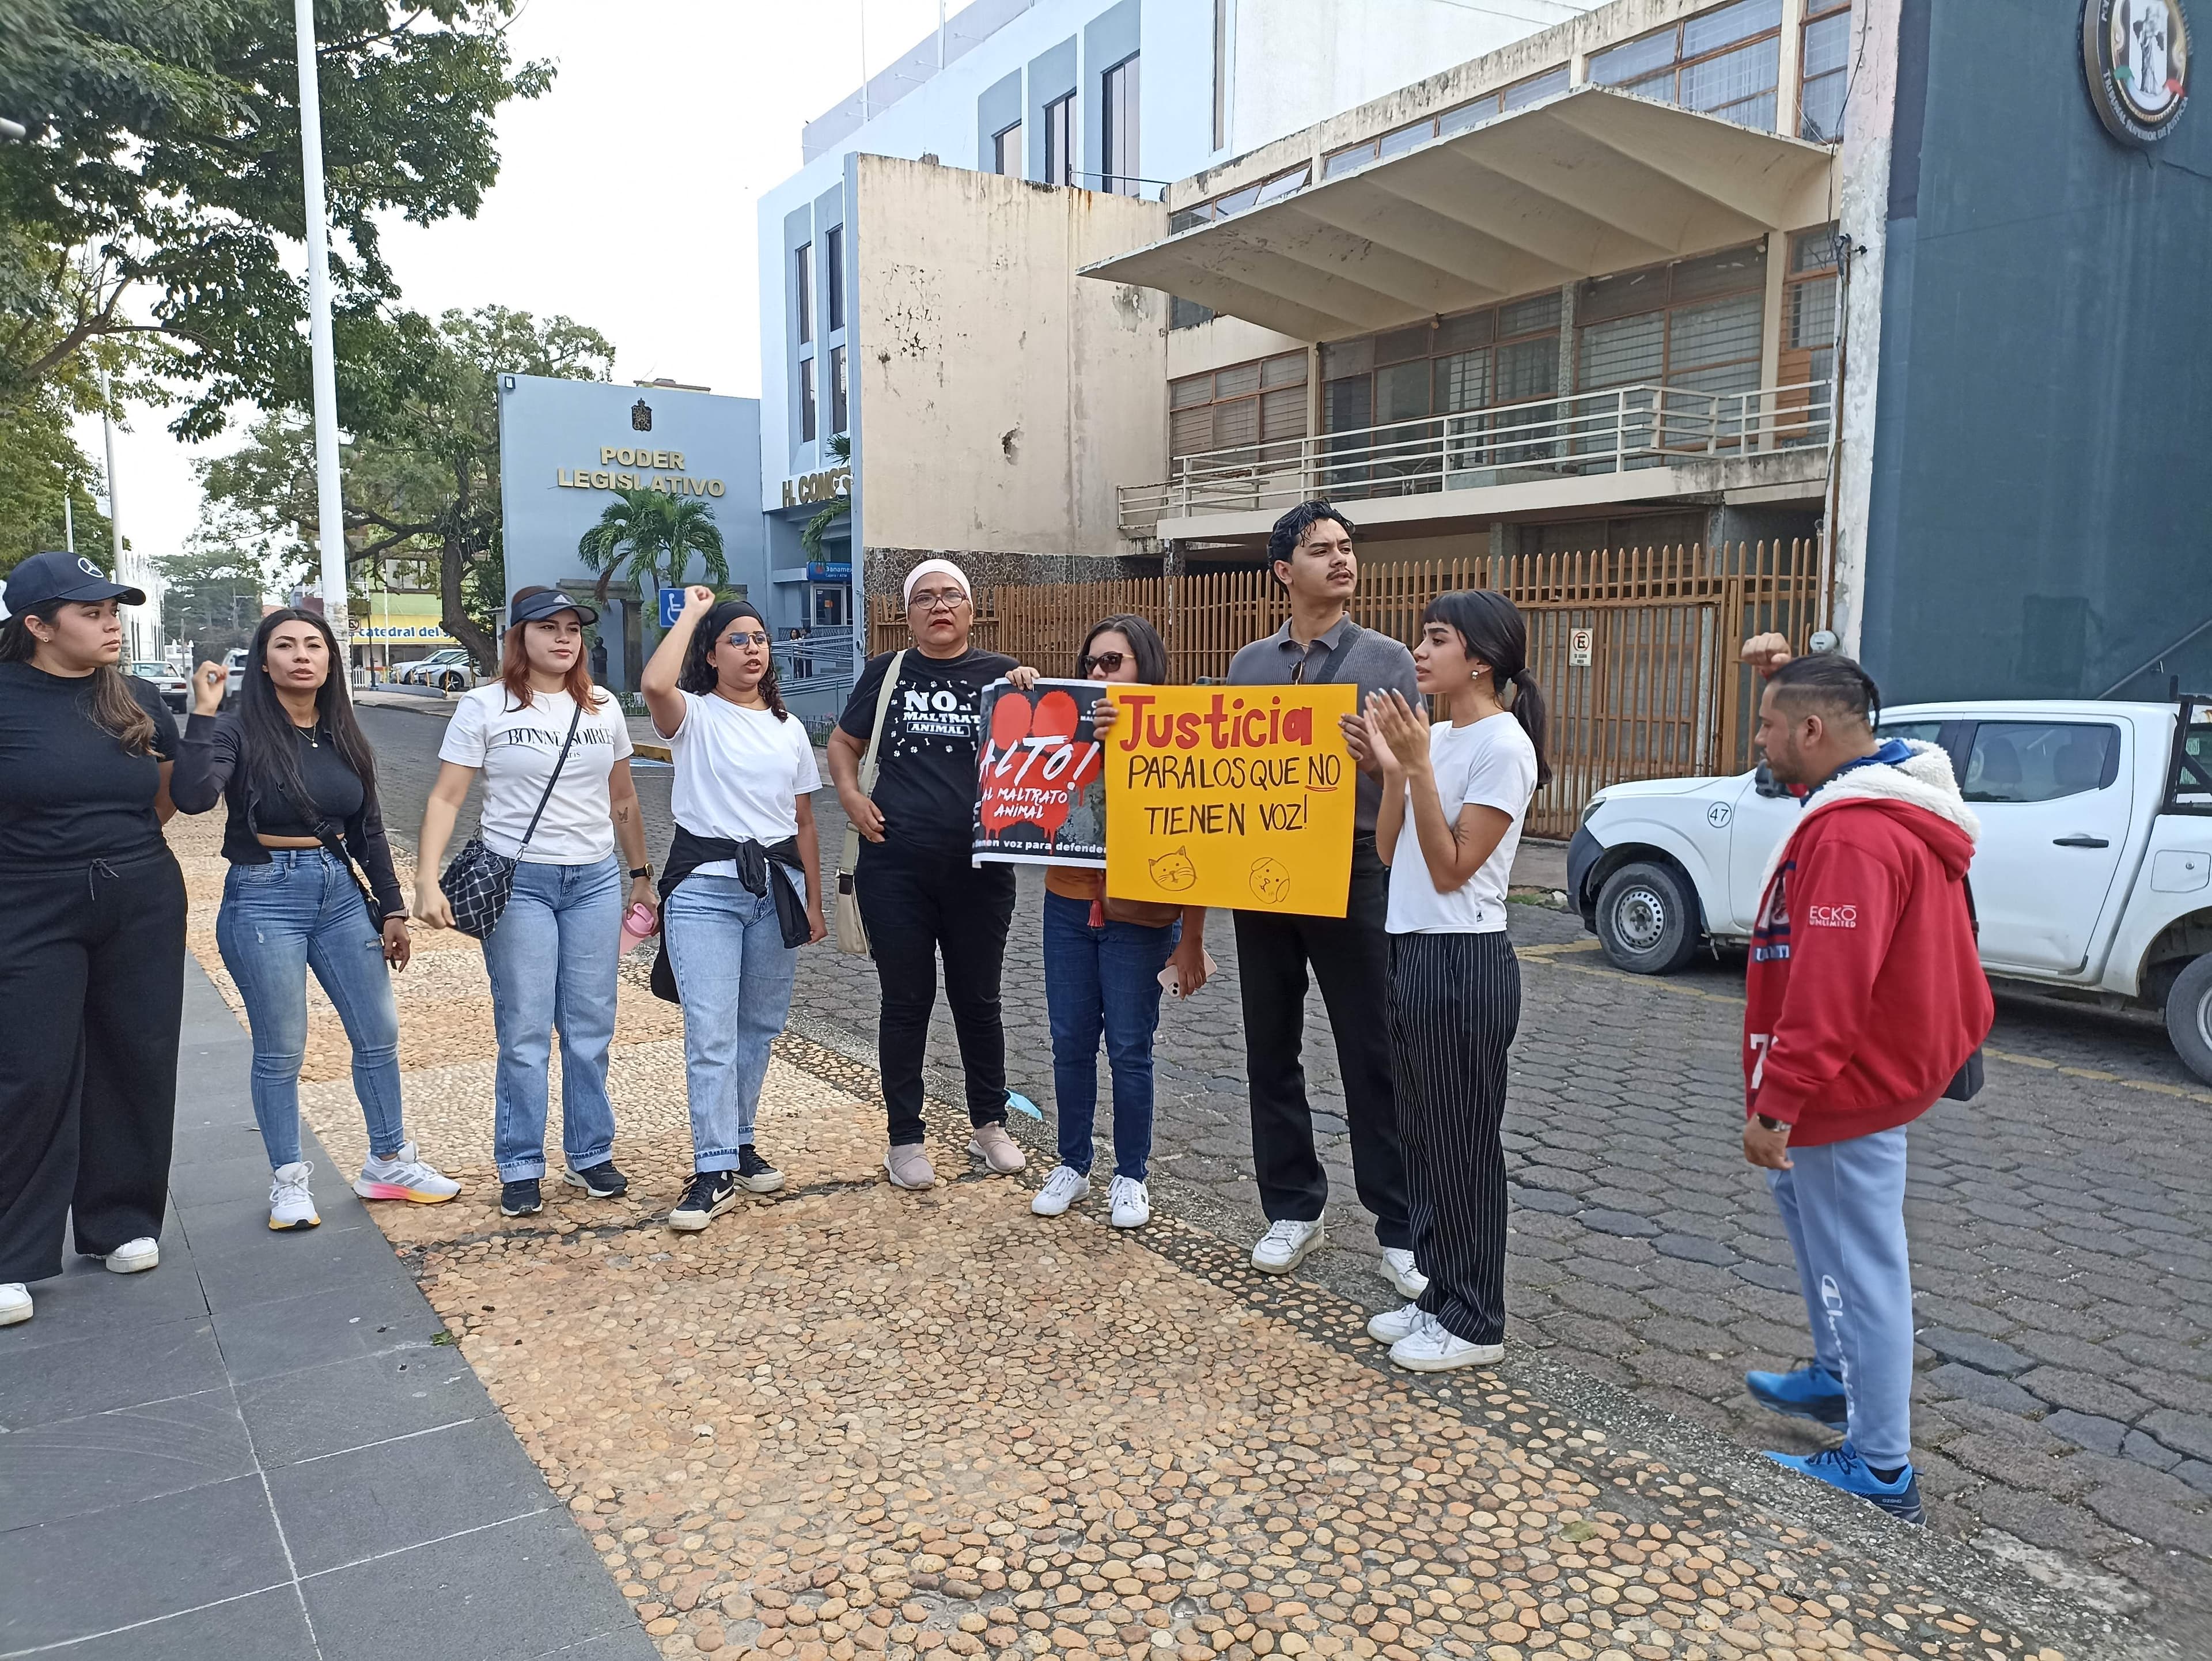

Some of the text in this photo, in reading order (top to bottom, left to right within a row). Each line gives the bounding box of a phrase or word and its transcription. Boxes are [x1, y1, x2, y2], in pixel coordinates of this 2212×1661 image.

[600, 445, 685, 471] PODER
[557, 467, 726, 497] LEGISLATIVO
[782, 479, 796, 508] H.
[359, 626, 415, 637] catedral
[418, 626, 440, 637] del
[903, 690, 972, 712] NO al
[903, 711, 981, 724] MALTRAT
[1119, 693, 1313, 752] Justicia
[508, 728, 564, 747] BONNE
[911, 723, 964, 735] ANIMAL
[978, 735, 1101, 791] ALTO!
[1249, 756, 1300, 792] QUE
[1308, 753, 1341, 786] NO
[982, 786, 1069, 807] AL MALTRATO
[994, 803, 1044, 819] ANIMAL
[1144, 793, 1308, 836] TIENEN VOZ!
[1710, 808, 1729, 822] 47
[1003, 840, 1023, 849] voz
[1025, 840, 1052, 850] para
[1809, 918, 1857, 928] UNLIMITED
[1750, 1034, 1779, 1089] 7
